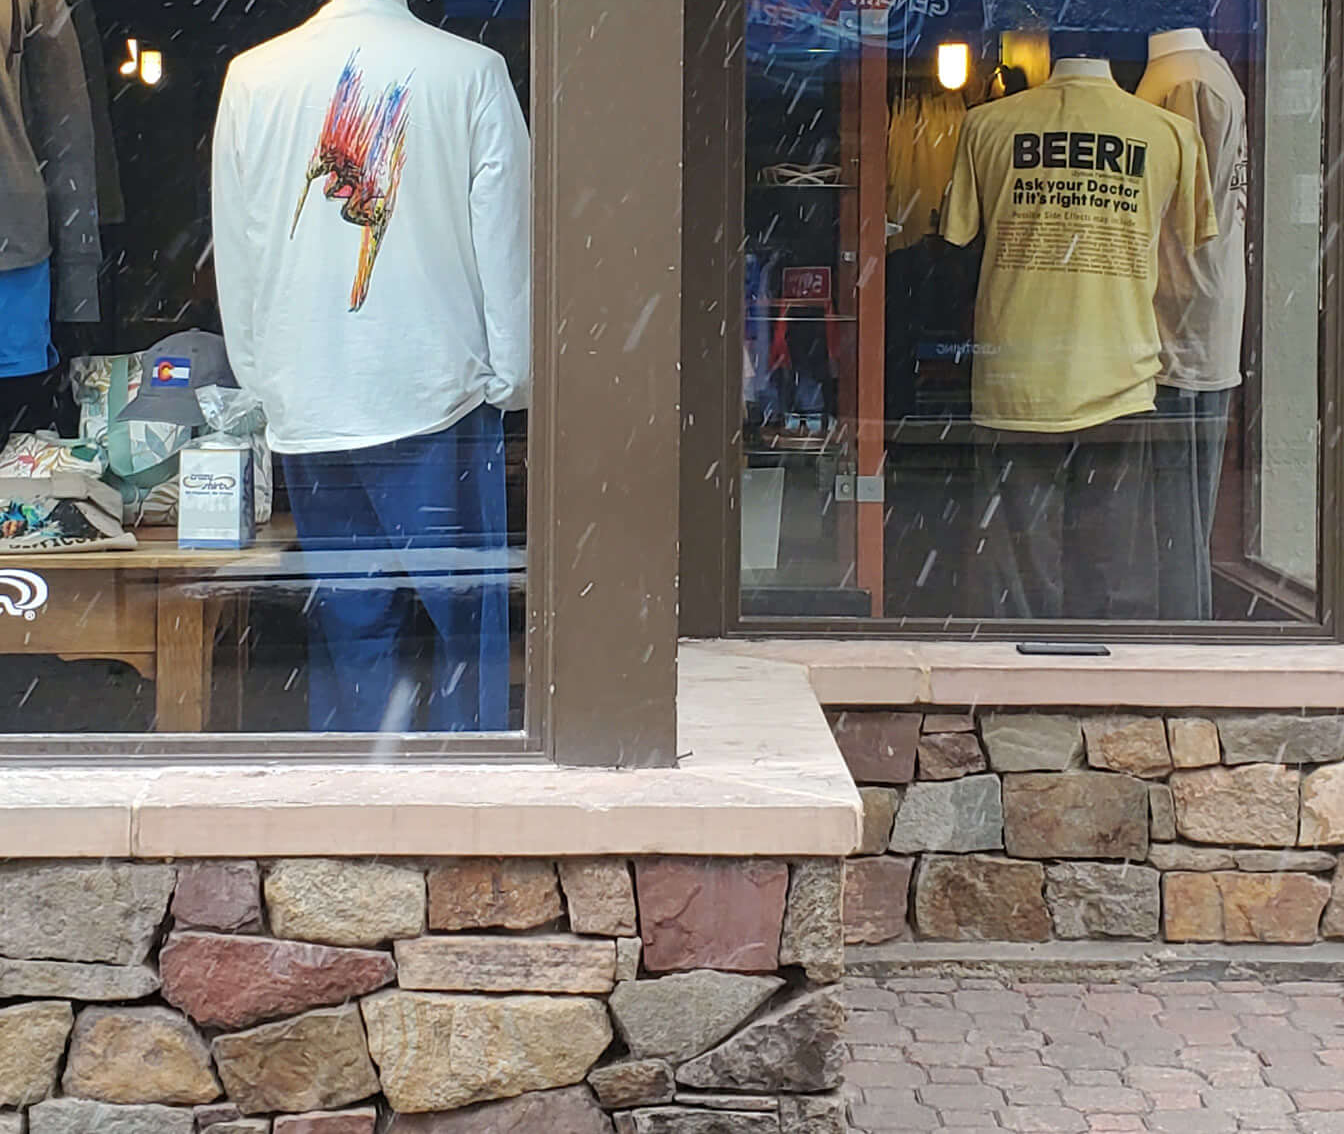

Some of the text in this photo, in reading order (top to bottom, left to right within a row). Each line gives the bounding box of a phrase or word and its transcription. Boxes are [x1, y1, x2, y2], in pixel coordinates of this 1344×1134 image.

[1013, 178, 1140, 199] Ask your Doctor
[1026, 192, 1047, 205] it's
[1049, 192, 1088, 208] right
[1089, 193, 1110, 208] for
[1113, 199, 1138, 213] you
